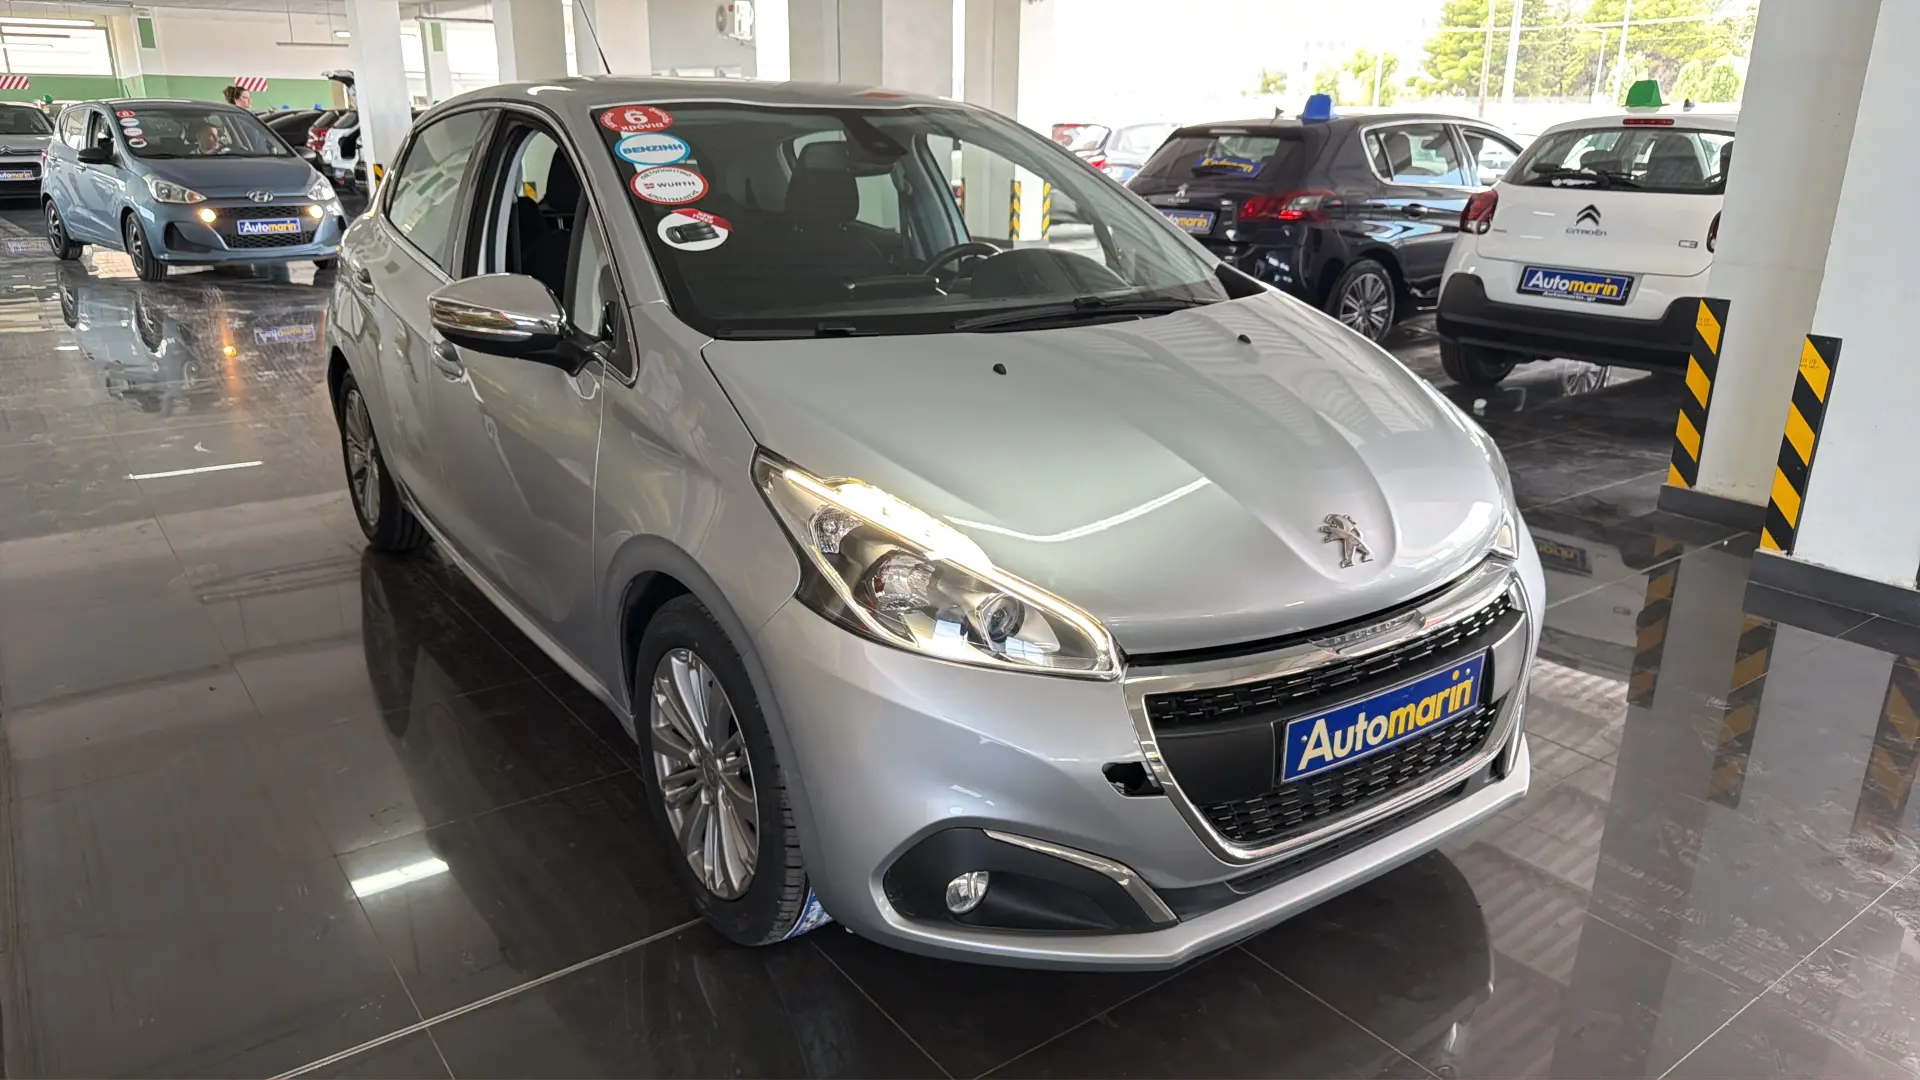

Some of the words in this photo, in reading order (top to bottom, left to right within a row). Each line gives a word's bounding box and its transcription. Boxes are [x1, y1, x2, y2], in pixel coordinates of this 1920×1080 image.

[624, 110, 649, 125] 6
[698, 211, 715, 221] NEW
[243, 220, 297, 233] Automarin
[1678, 240, 1698, 248] C3
[1528, 271, 1619, 297] Automarin
[1297, 670, 1475, 772] Automarin
